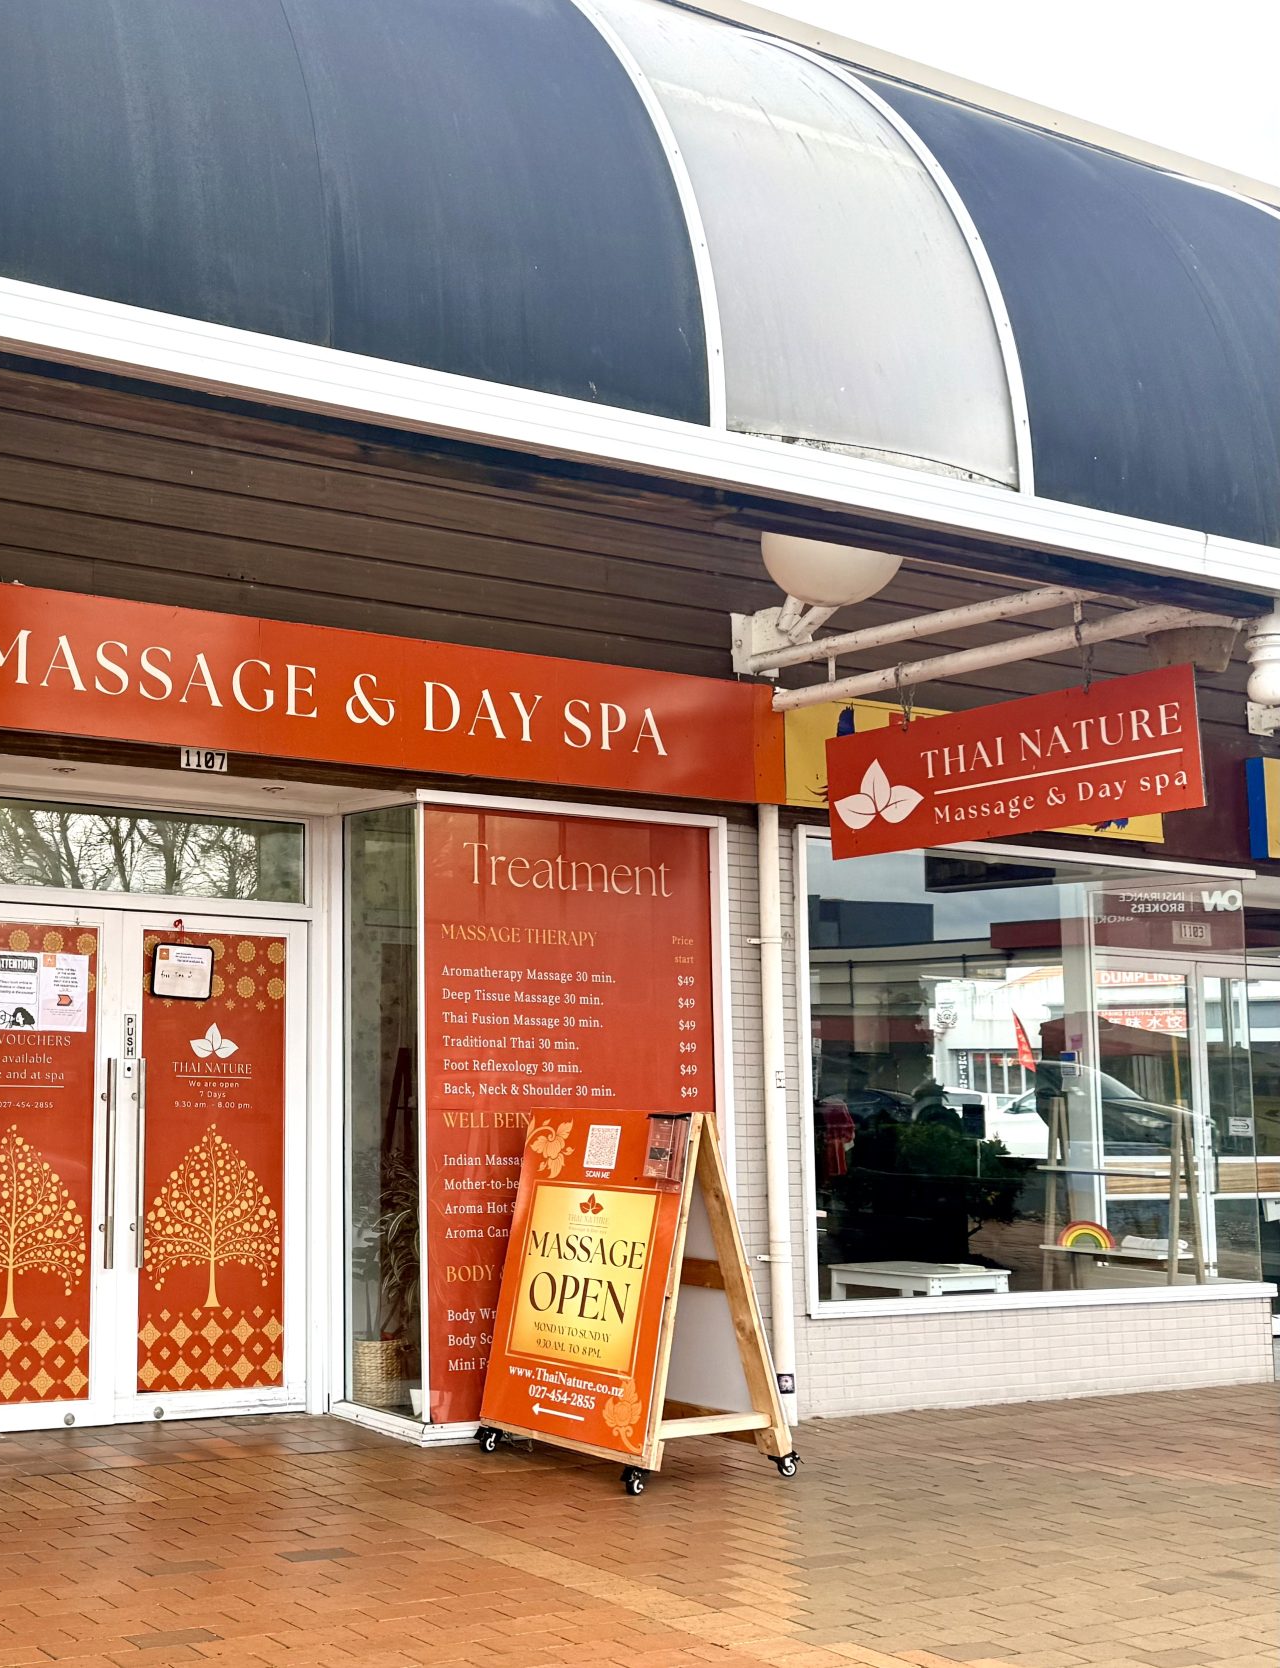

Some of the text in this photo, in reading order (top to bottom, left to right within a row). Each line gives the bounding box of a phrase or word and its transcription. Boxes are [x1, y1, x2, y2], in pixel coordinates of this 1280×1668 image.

[345, 673, 396, 726] &
[424, 681, 543, 742] DAY
[564, 700, 668, 756] SPA
[921, 702, 1182, 779] THAI NATURE
[183, 748, 226, 771] 1107
[934, 770, 1188, 826] Massage & Day spa
[463, 842, 673, 898] Treatment
[441, 924, 598, 947] MASSAGE THERAPY
[672, 935, 694, 945] Price
[441, 965, 695, 986] Aromatherapy Massage 30 min. $49
[442, 988, 695, 1008] Deep Tissue Massage 30 min. $49
[442, 1012, 696, 1031] Thai Fusion Massage 30 min. $49
[442, 1036, 697, 1053] Traditional Thai 30 min. $49
[2, 1053, 53, 1064] available
[6, 1069, 27, 1079] and
[31, 1071, 41, 1080] at
[45, 1072, 65, 1083] spa
[172, 1061, 252, 1074] THAI NATURE
[443, 1059, 698, 1076] Foot Reflexology 30 min. $49
[207, 1091, 226, 1099] Days
[444, 1083, 698, 1098] Back, Neck & Shoulder 30 min. $49
[443, 1112, 490, 1128] WELL
[443, 1154, 481, 1166] Indian
[585, 1170, 610, 1179] SCAN ME
[444, 1203, 483, 1214] Aroma
[487, 1202, 507, 1214] Hot
[445, 1225, 509, 1239] Aroma Can
[528, 1230, 646, 1270] MASSAGE
[446, 1264, 495, 1282] BODY
[529, 1271, 631, 1324] OPEN
[447, 1308, 476, 1323] Body
[448, 1333, 477, 1348] Body
[534, 1321, 612, 1343] MONDAY TO SUNDAY
[568, 1343, 580, 1354] TO
[581, 1346, 587, 1356] 8
[448, 1357, 476, 1371] Mini
[508, 1365, 625, 1398] www.ThaiNature.co.nz
[528, 1384, 596, 1410] 027-454-2855
